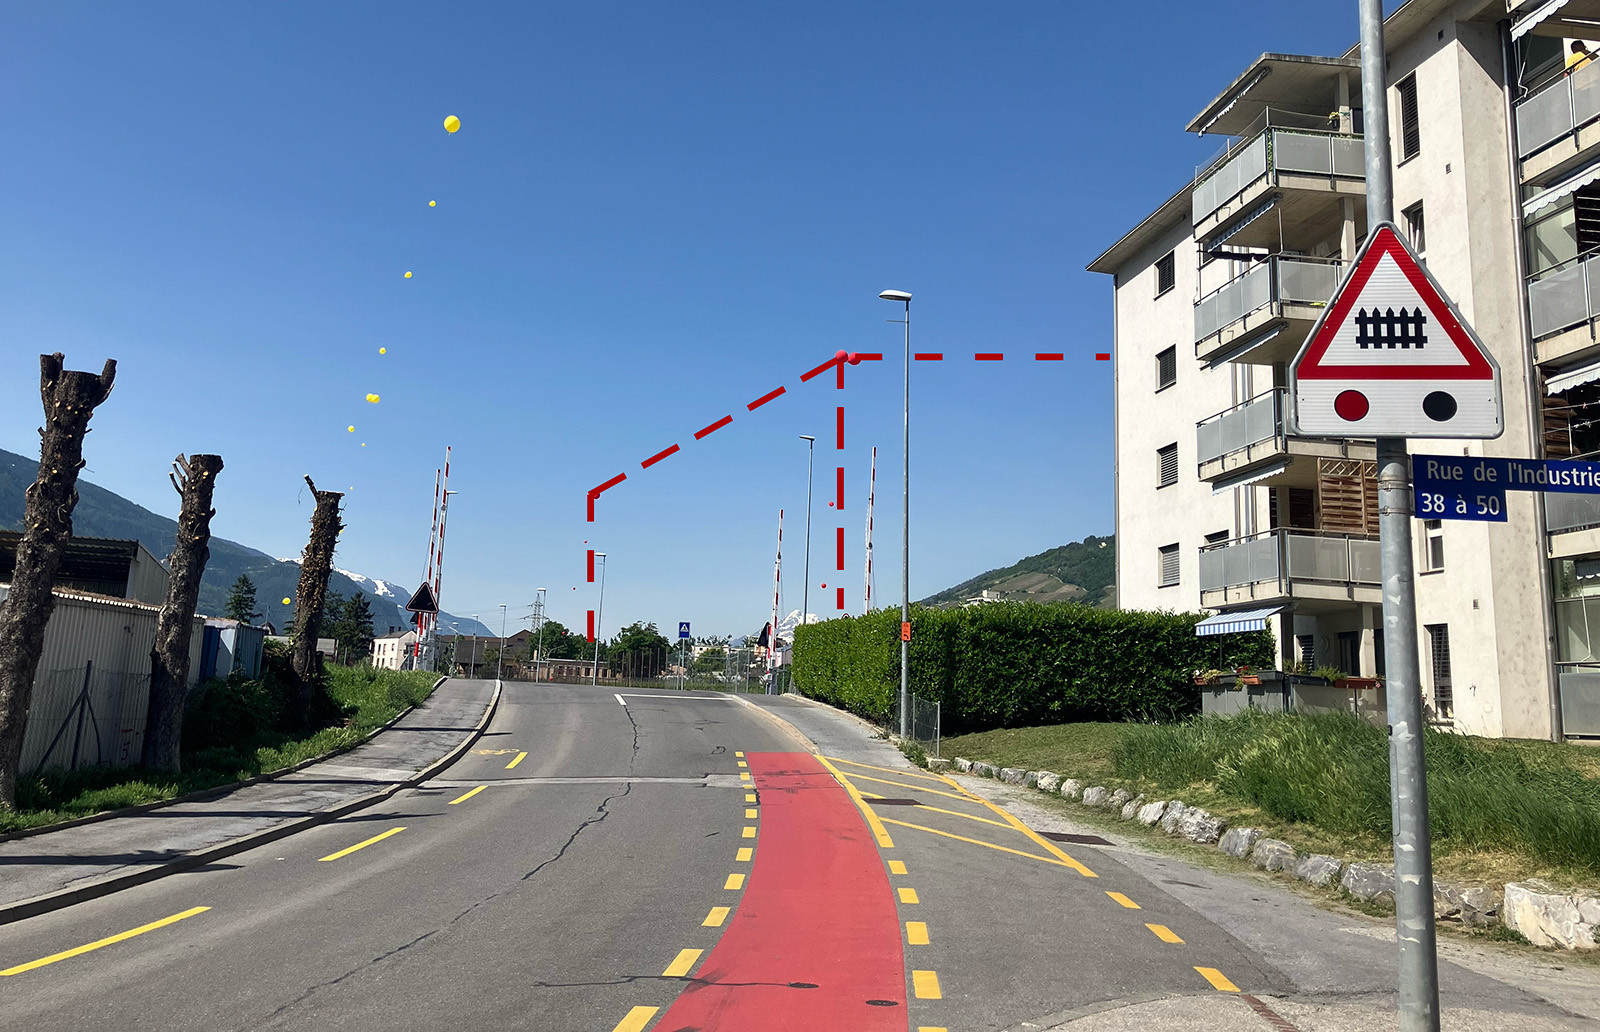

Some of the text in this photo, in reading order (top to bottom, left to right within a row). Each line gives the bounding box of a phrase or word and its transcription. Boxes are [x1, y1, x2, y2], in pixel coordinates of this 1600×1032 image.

[1427, 460, 1600, 488] Rue de l'Industrie
[1421, 492, 1500, 516] 38 à 50
